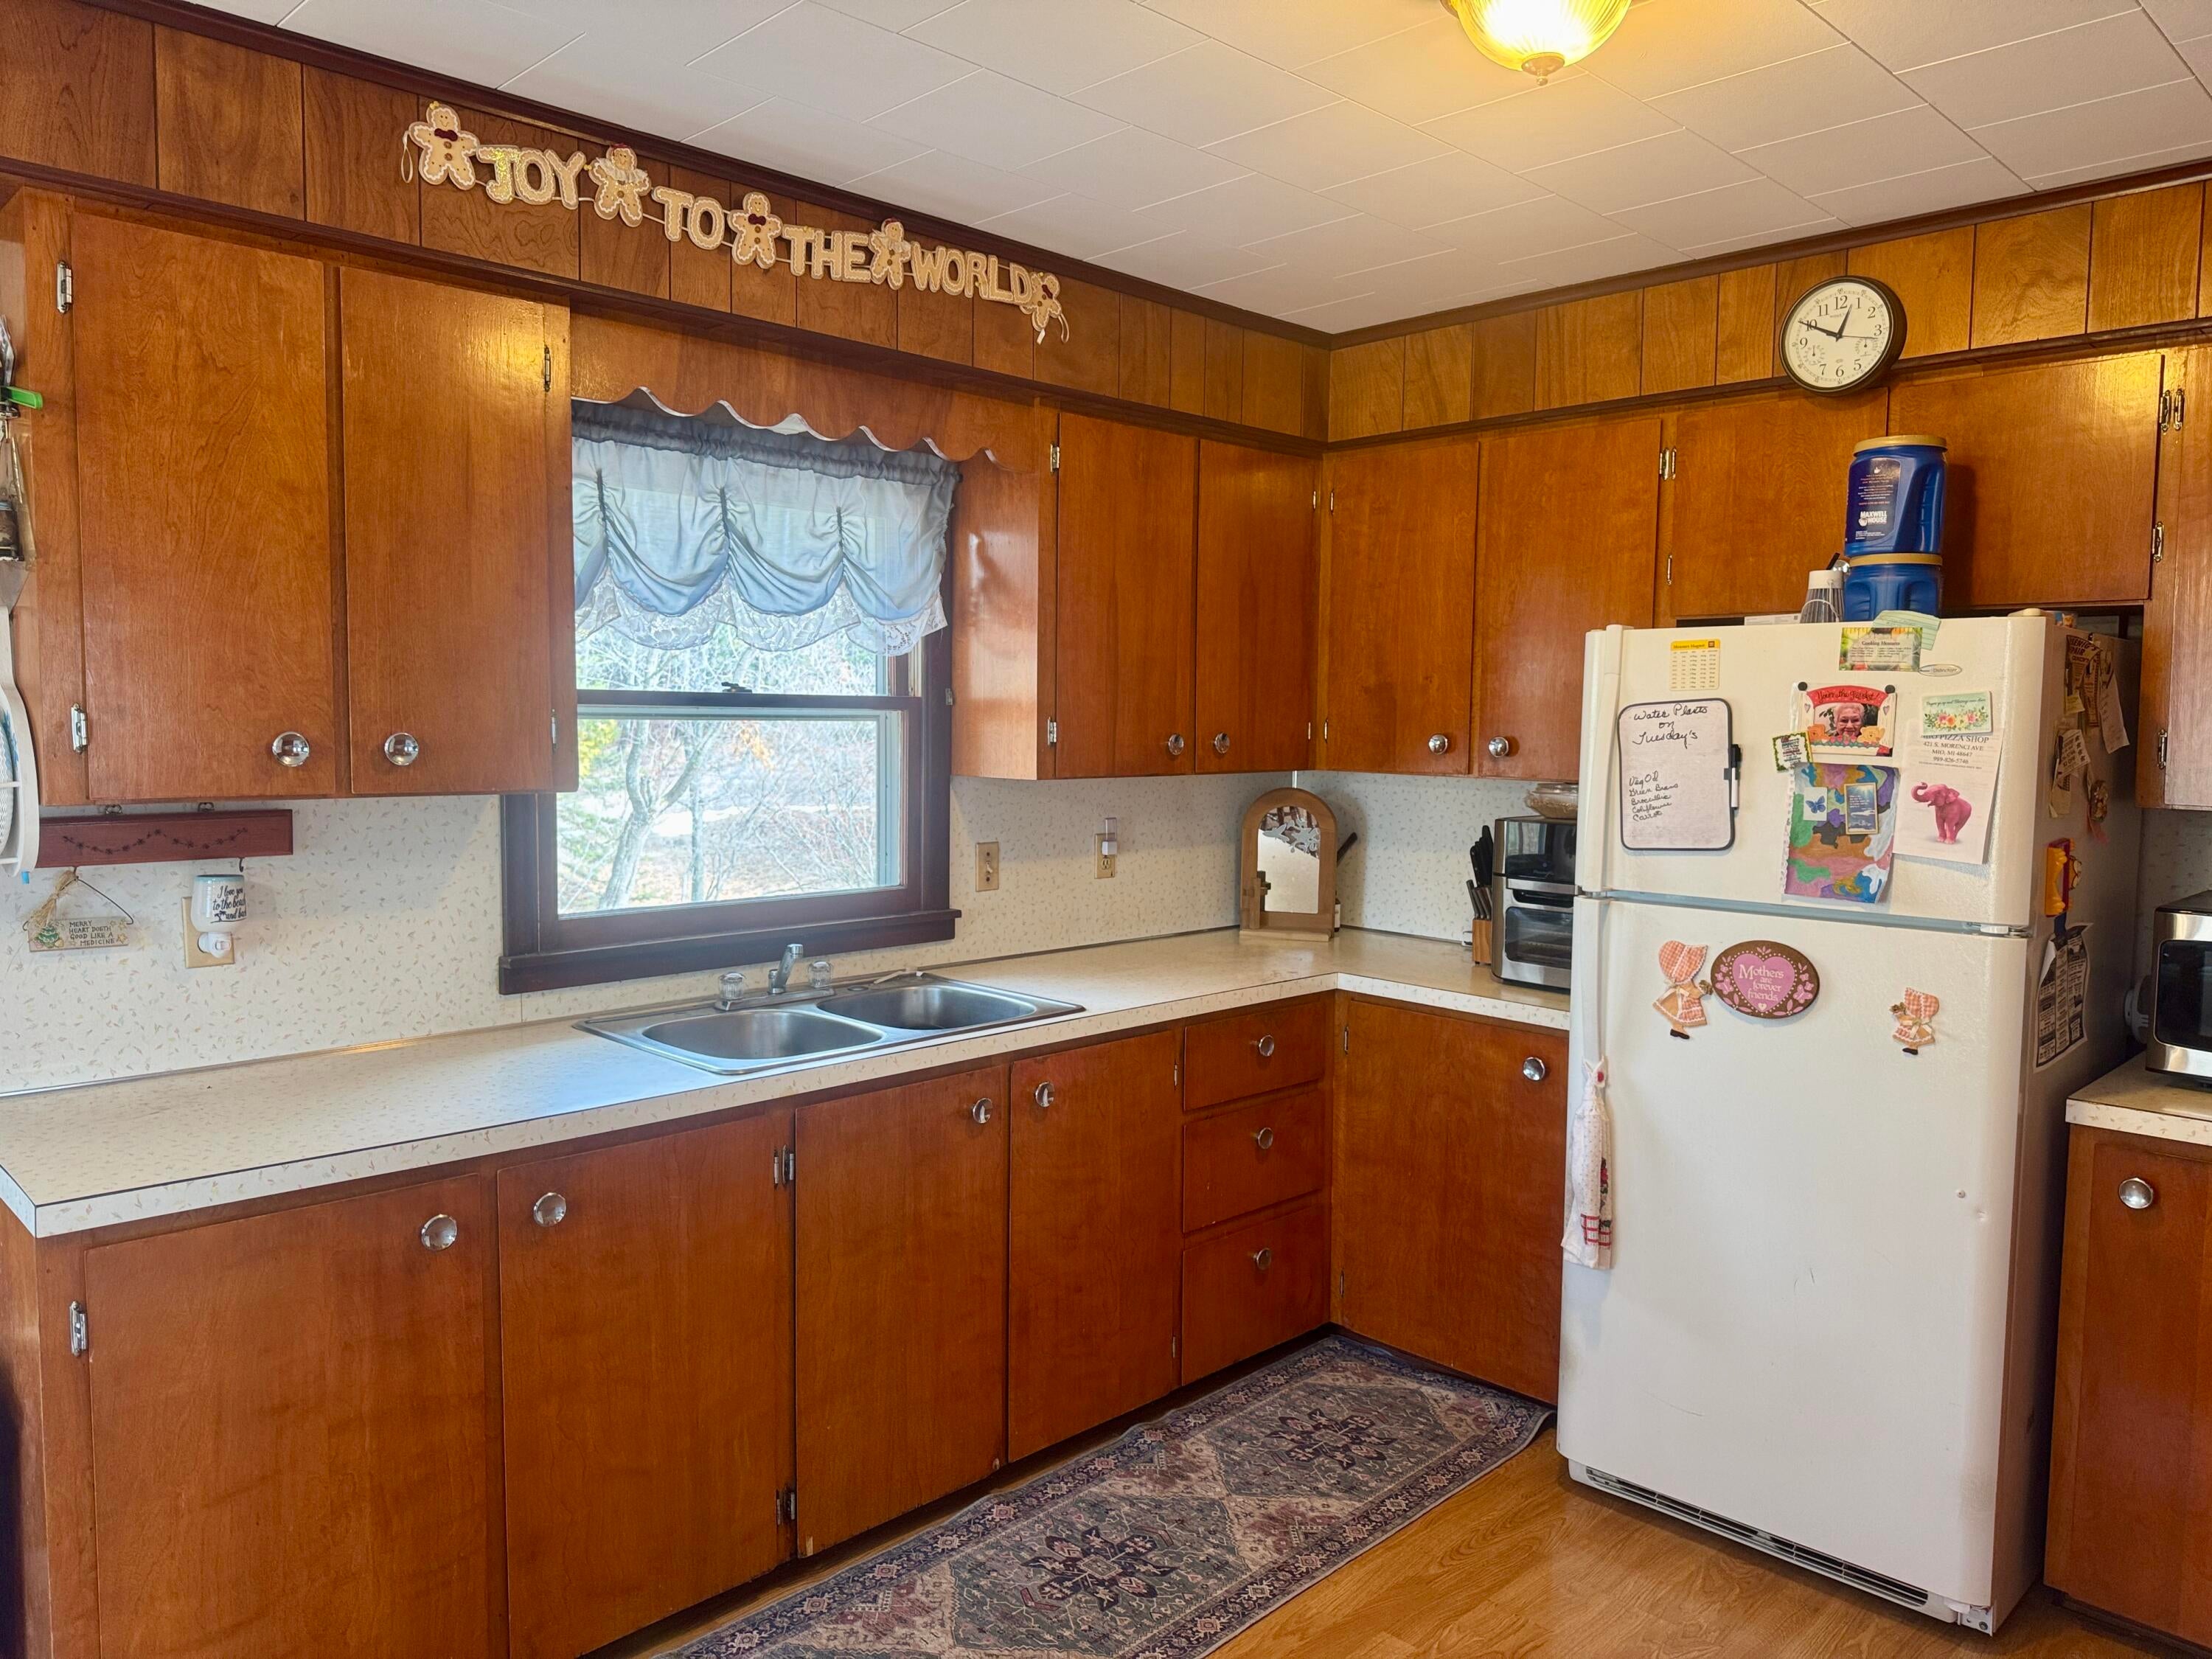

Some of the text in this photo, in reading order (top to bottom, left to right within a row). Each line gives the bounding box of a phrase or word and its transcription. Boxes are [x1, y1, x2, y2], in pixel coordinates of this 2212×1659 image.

[476, 145, 1033, 305] JOY TO THE WORLD
[1834, 295, 1848, 310] 12
[1855, 297, 1863, 309] 1
[1818, 303, 1829, 317] 11
[1867, 306, 1876, 319] 2
[1806, 319, 1818, 332] 10
[1874, 324, 1882, 336] 3
[1799, 337, 1808, 349] 9
[1819, 364, 1826, 375] 7
[1835, 364, 1844, 378] 6
[1853, 358, 1862, 372] 5
[1860, 510, 1888, 518] MAXWELL
[1634, 710, 1669, 720] Water
[1659, 721, 1674, 731] on
[1632, 730, 1698, 749] Tuesday's
[1939, 734, 1964, 742] PIZZA
[1965, 735, 1989, 744] SHOP
[1629, 776, 1644, 788] Veg
[1628, 787, 1652, 797] Green
[223, 885, 235, 897] love
[234, 887, 243, 900] you
[212, 898, 220, 911] to
[220, 896, 233, 910] the
[226, 908, 237, 920] and
[80, 938, 115, 946] MEDICINE
[1739, 964, 1784, 980] Mothers
[1753, 979, 1782, 992] forever
